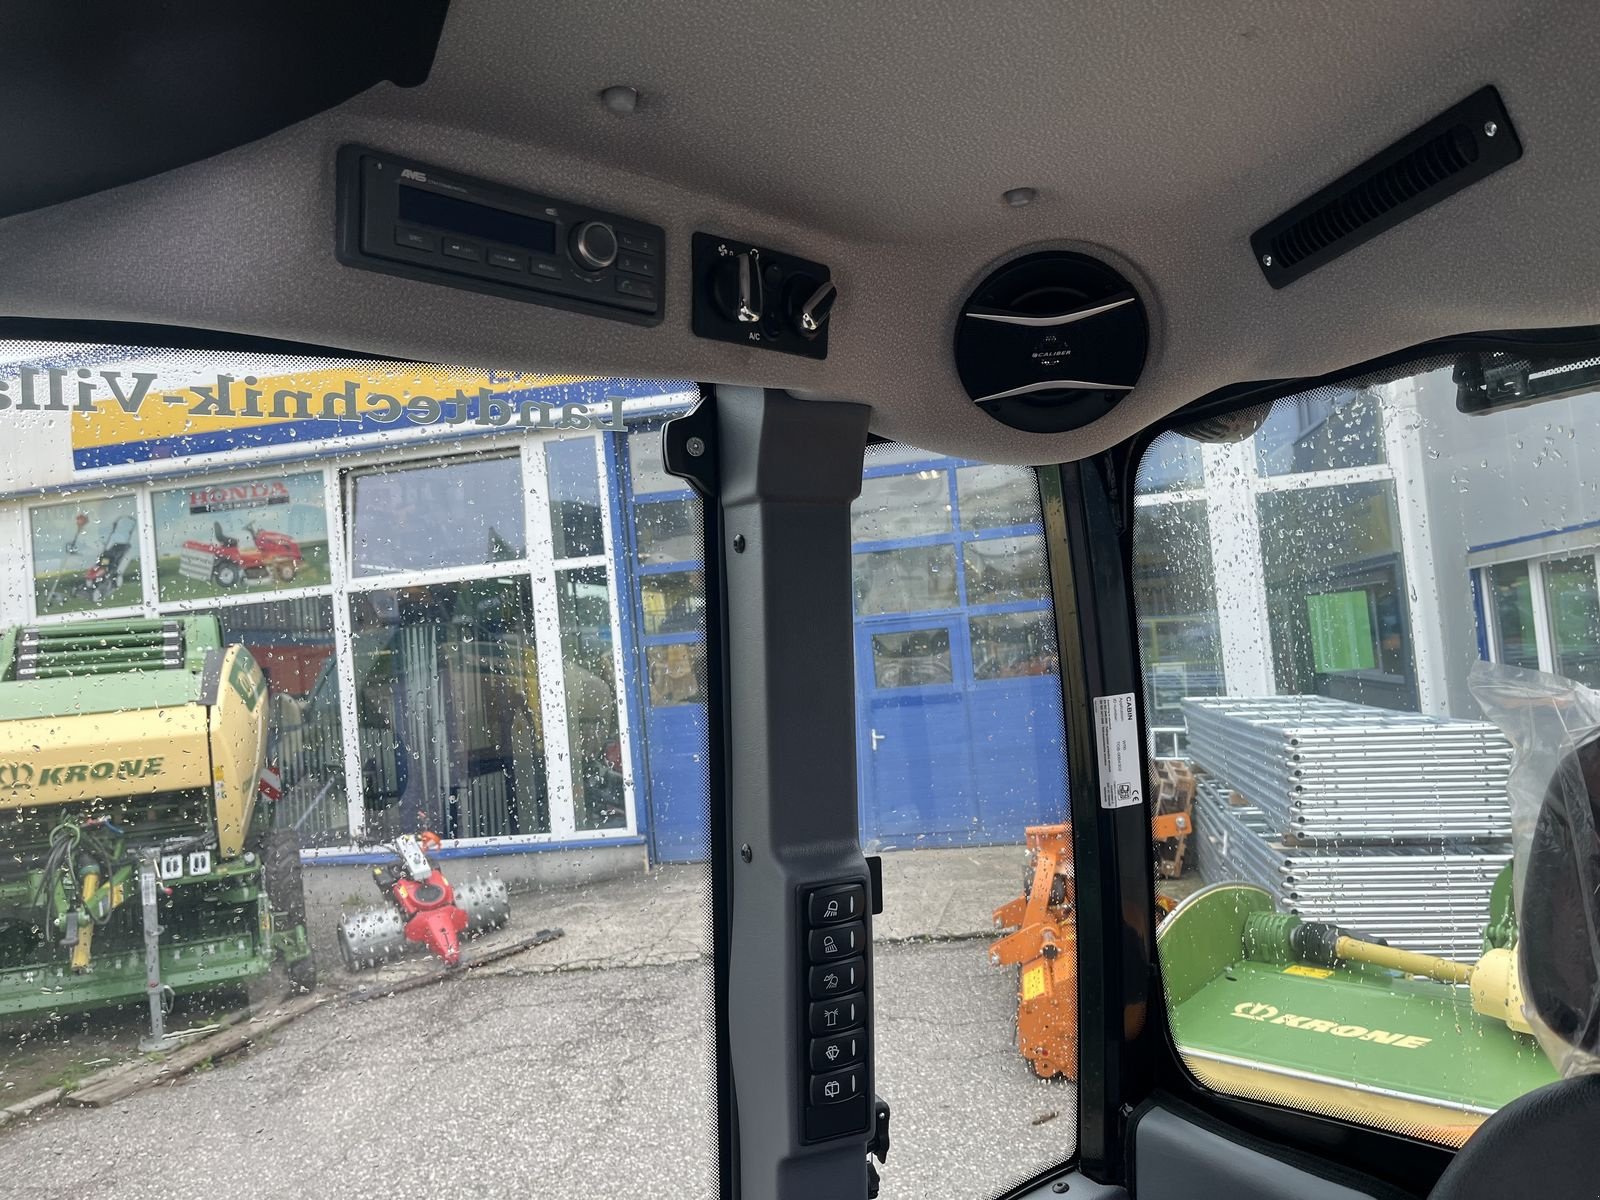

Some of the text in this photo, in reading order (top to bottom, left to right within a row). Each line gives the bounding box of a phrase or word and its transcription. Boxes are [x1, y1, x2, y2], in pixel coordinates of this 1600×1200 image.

[749, 332, 761, 341] A/C
[190, 481, 288, 505] HONDA
[1126, 696, 1134, 721] CABIN
[38, 756, 165, 786] KRONE
[1270, 1012, 1433, 1049] KRONE
